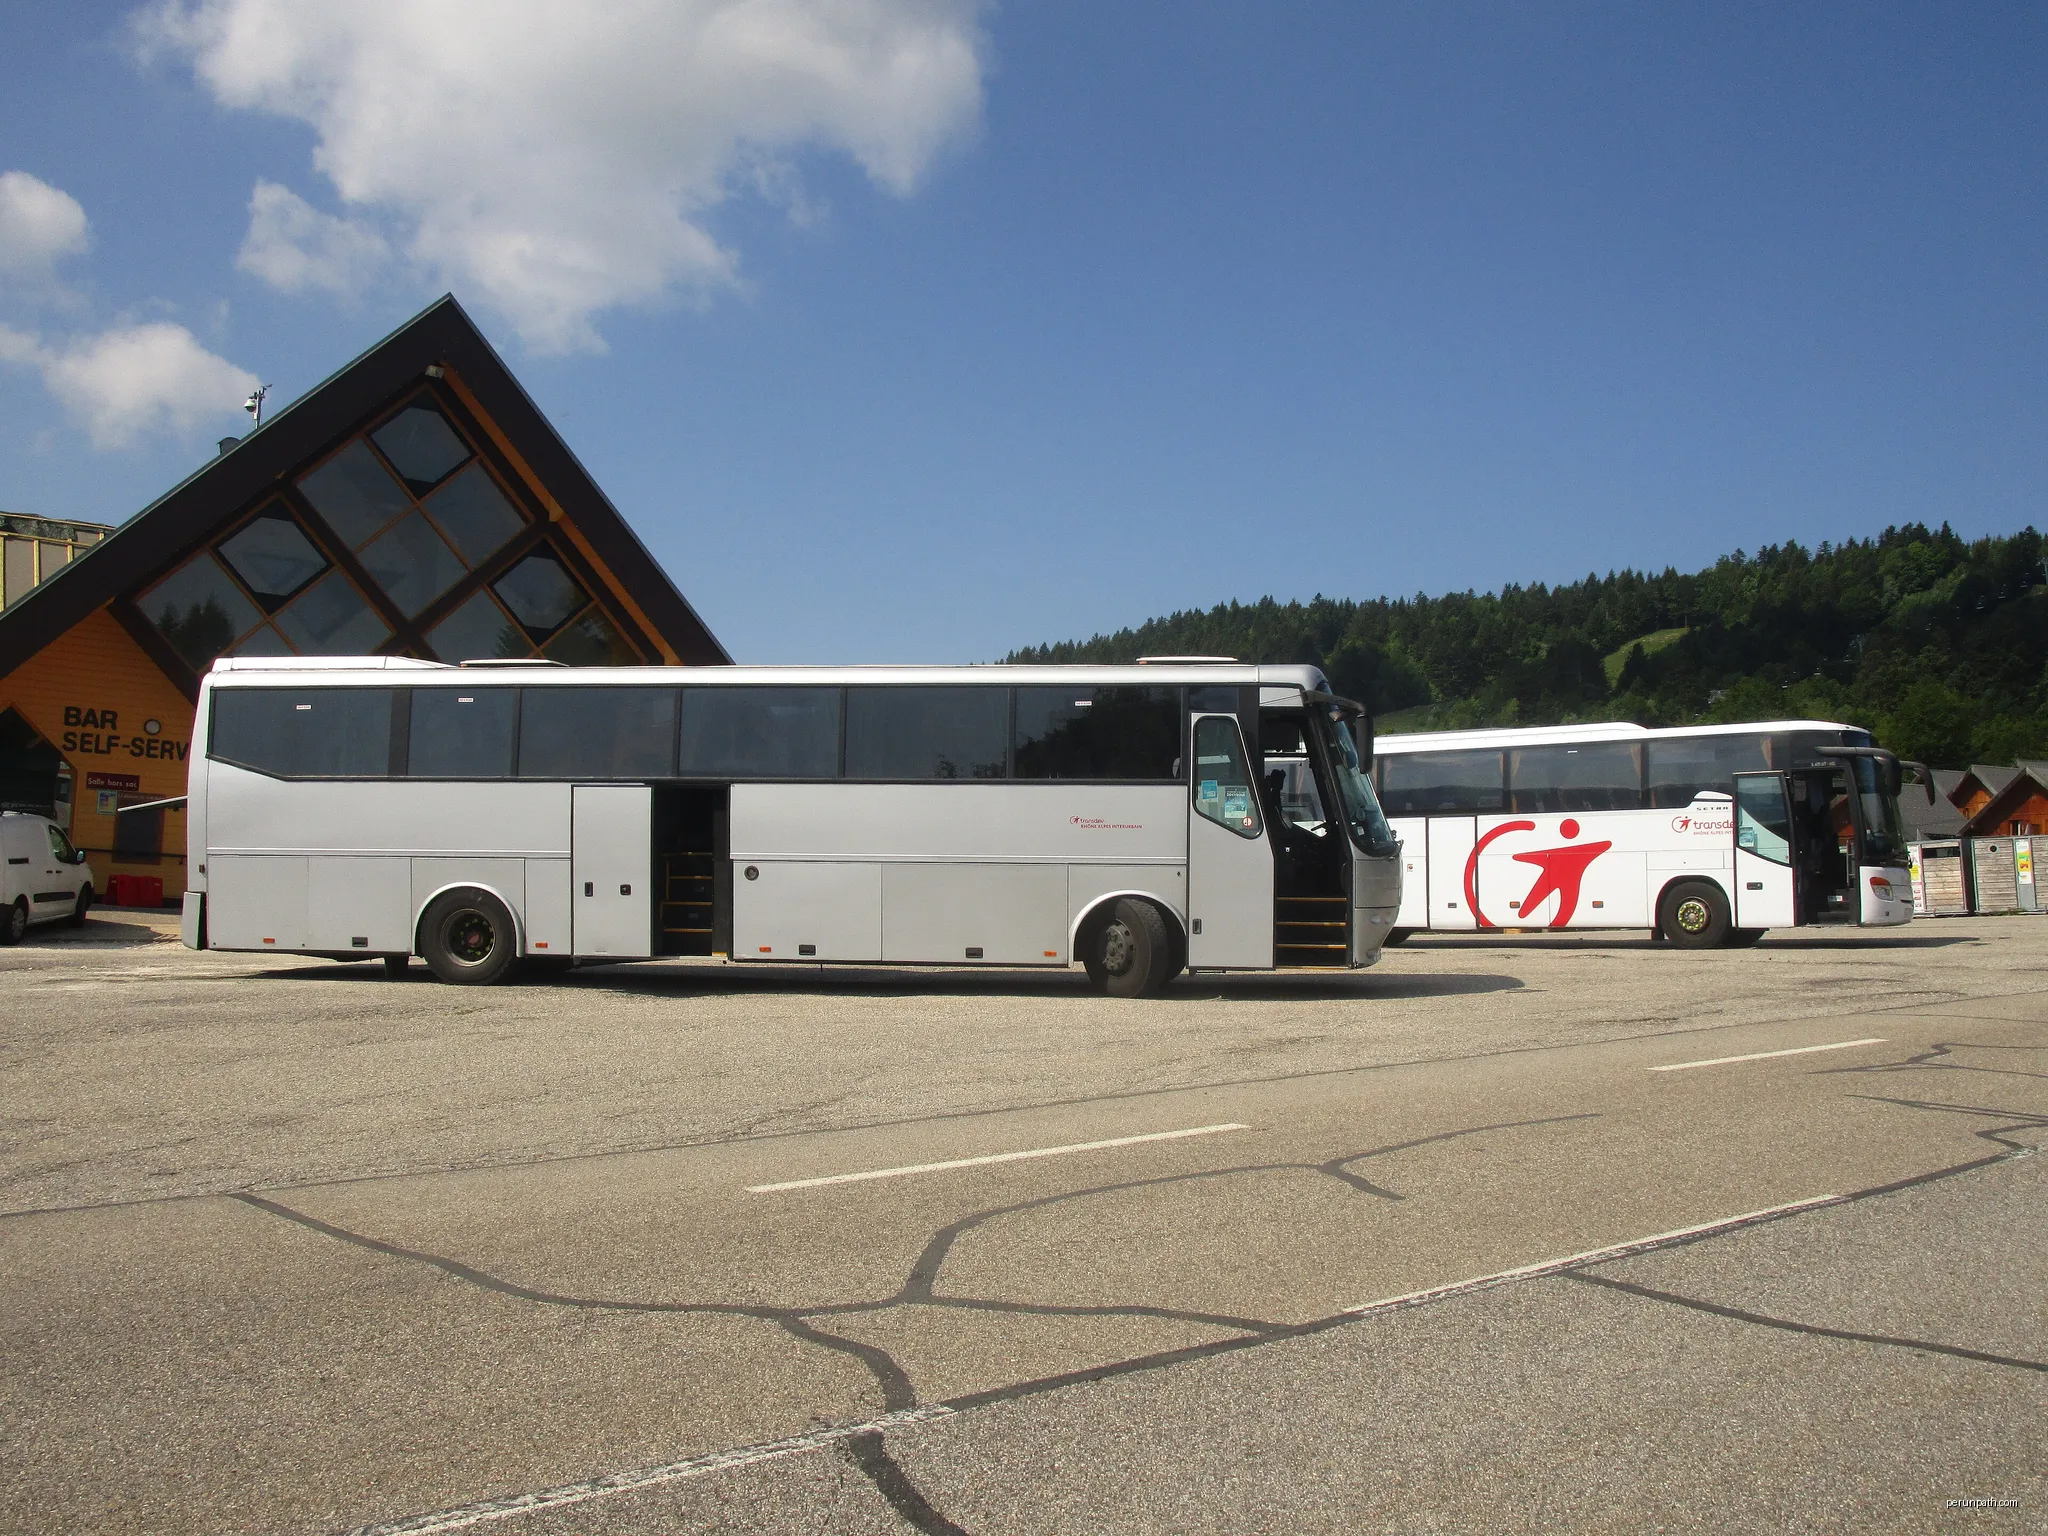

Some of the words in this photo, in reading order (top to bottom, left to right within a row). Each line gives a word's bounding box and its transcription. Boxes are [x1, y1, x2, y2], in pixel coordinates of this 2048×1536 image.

[64, 706, 118, 730] BAR
[62, 731, 189, 761] SELF-SERV
[88, 777, 104, 785] Salle
[107, 779, 123, 787] hors
